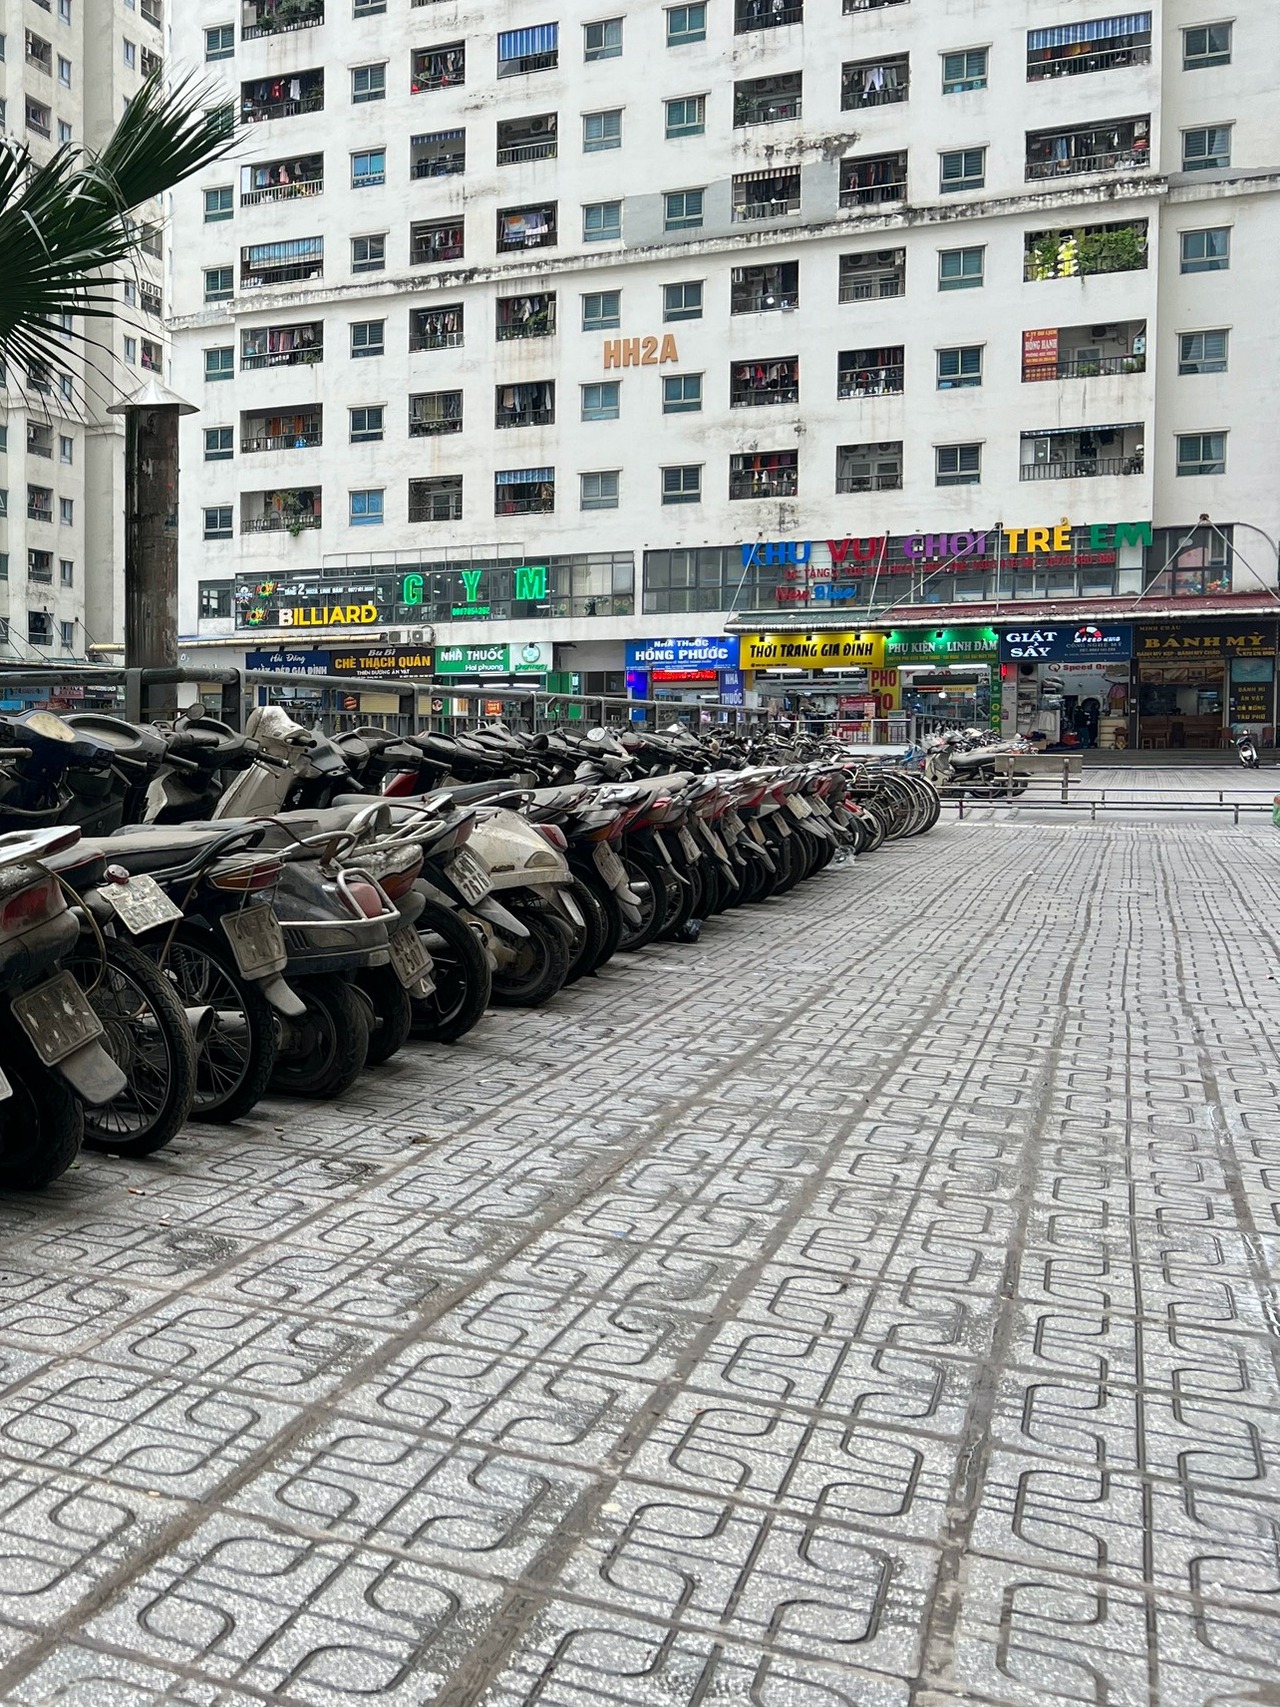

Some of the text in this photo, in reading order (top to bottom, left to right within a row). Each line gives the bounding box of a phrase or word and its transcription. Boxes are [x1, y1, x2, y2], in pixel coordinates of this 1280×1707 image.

[604, 334, 678, 369] HH2A
[742, 540, 812, 566] KHU
[826, 536, 888, 563] VUI
[1004, 517, 1072, 553] TRẺ
[1091, 521, 1153, 549] EM
[298, 583, 305, 595] 2
[278, 604, 378, 626] BILLIARD
[888, 642, 908, 654] PHỤ
[947, 640, 971, 651] LINH
[1144, 634, 1221, 649] BÁNH
[467, 646, 504, 661] THUỐC
[635, 646, 728, 661] HỒNG PHƯỚC
[780, 643, 817, 657] TRANG
[821, 643, 839, 656] GIA
[335, 654, 430, 669] CHÈ THẠCH QUÁN
[1063, 663, 1093, 671] Speed
[463, 872, 490, 900] 7676
